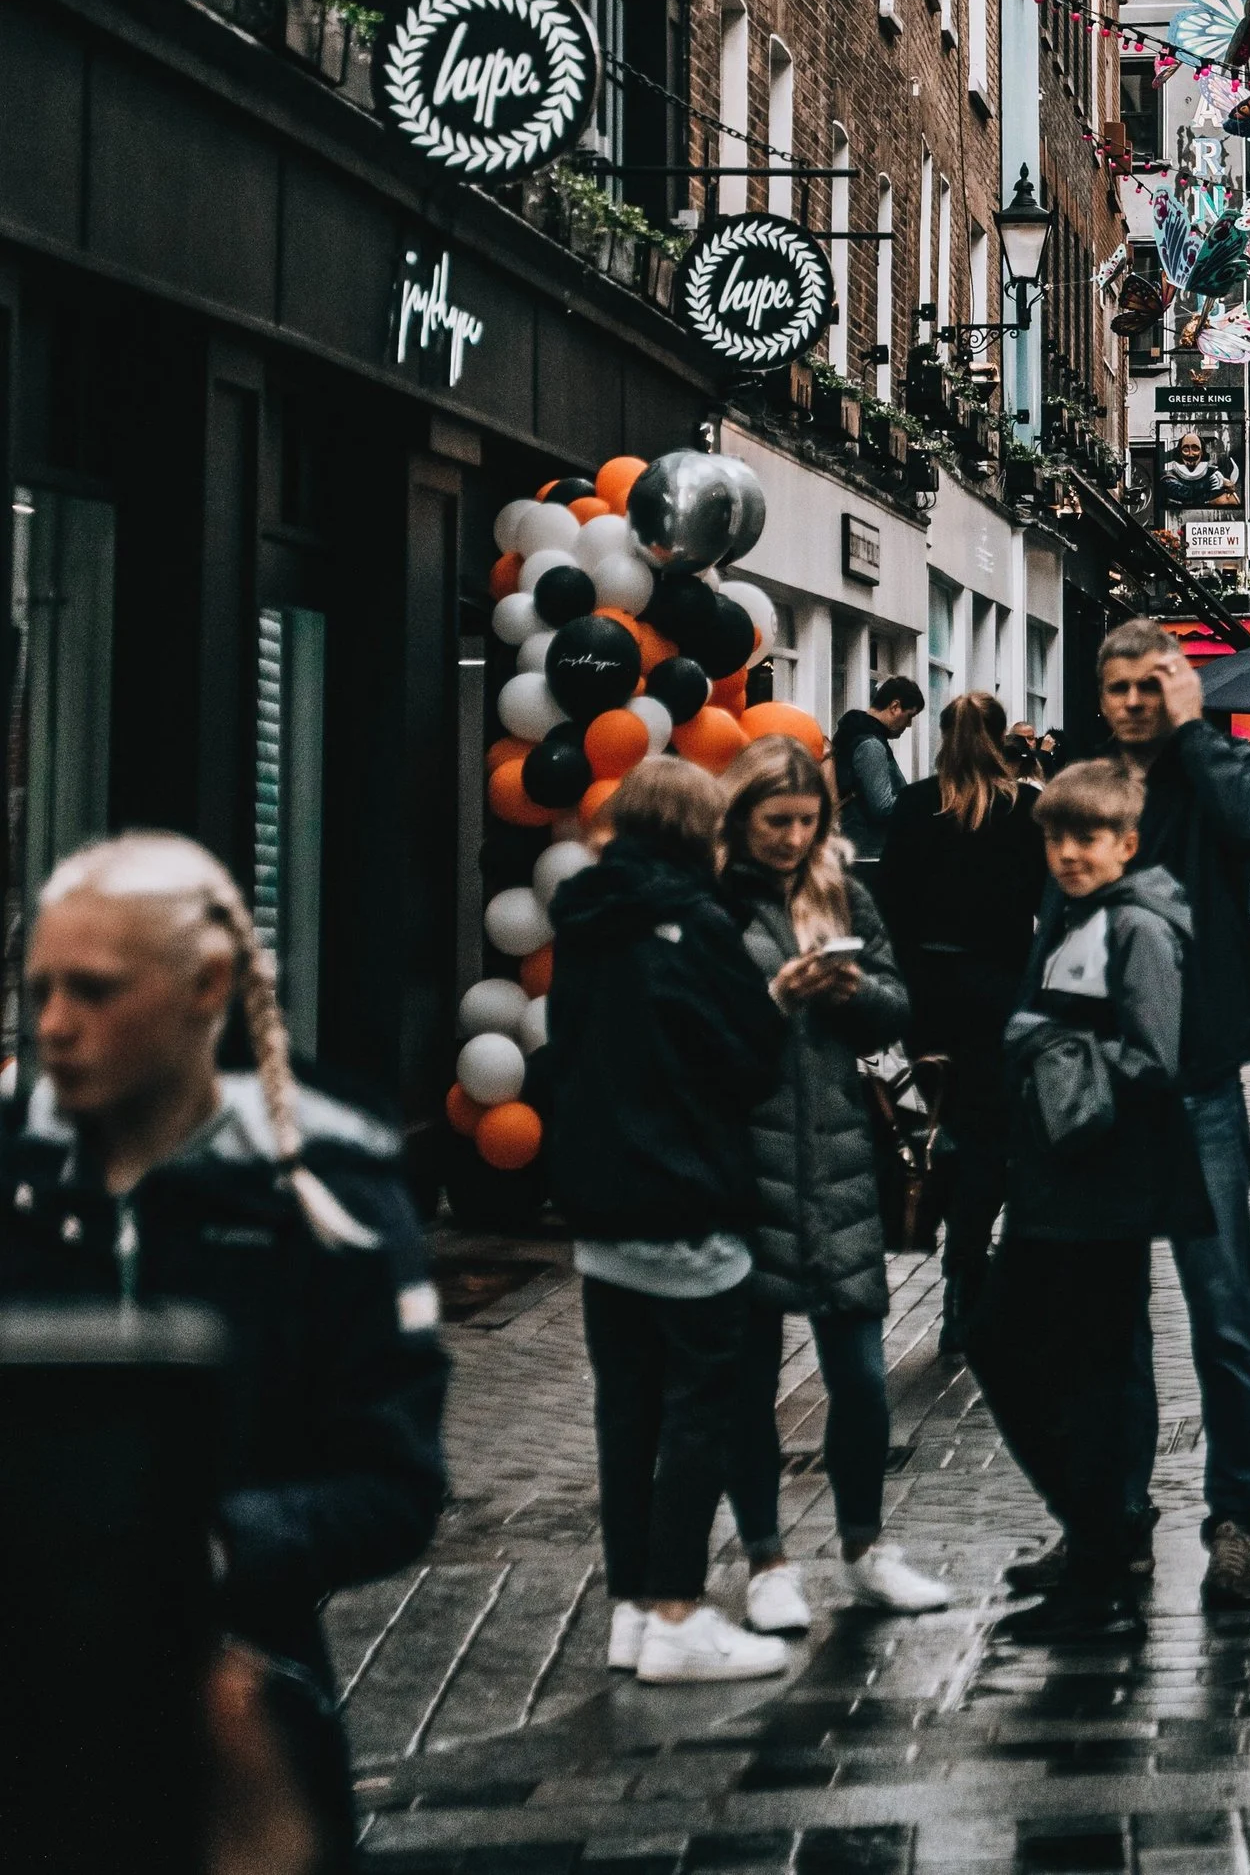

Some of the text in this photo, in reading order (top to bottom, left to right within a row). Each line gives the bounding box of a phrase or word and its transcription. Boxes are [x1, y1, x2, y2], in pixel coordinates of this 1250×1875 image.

[1168, 395, 1232, 403] GREENE KING
[1191, 527, 1231, 536] CARNABY
[1191, 537, 1239, 546] STREET W1
